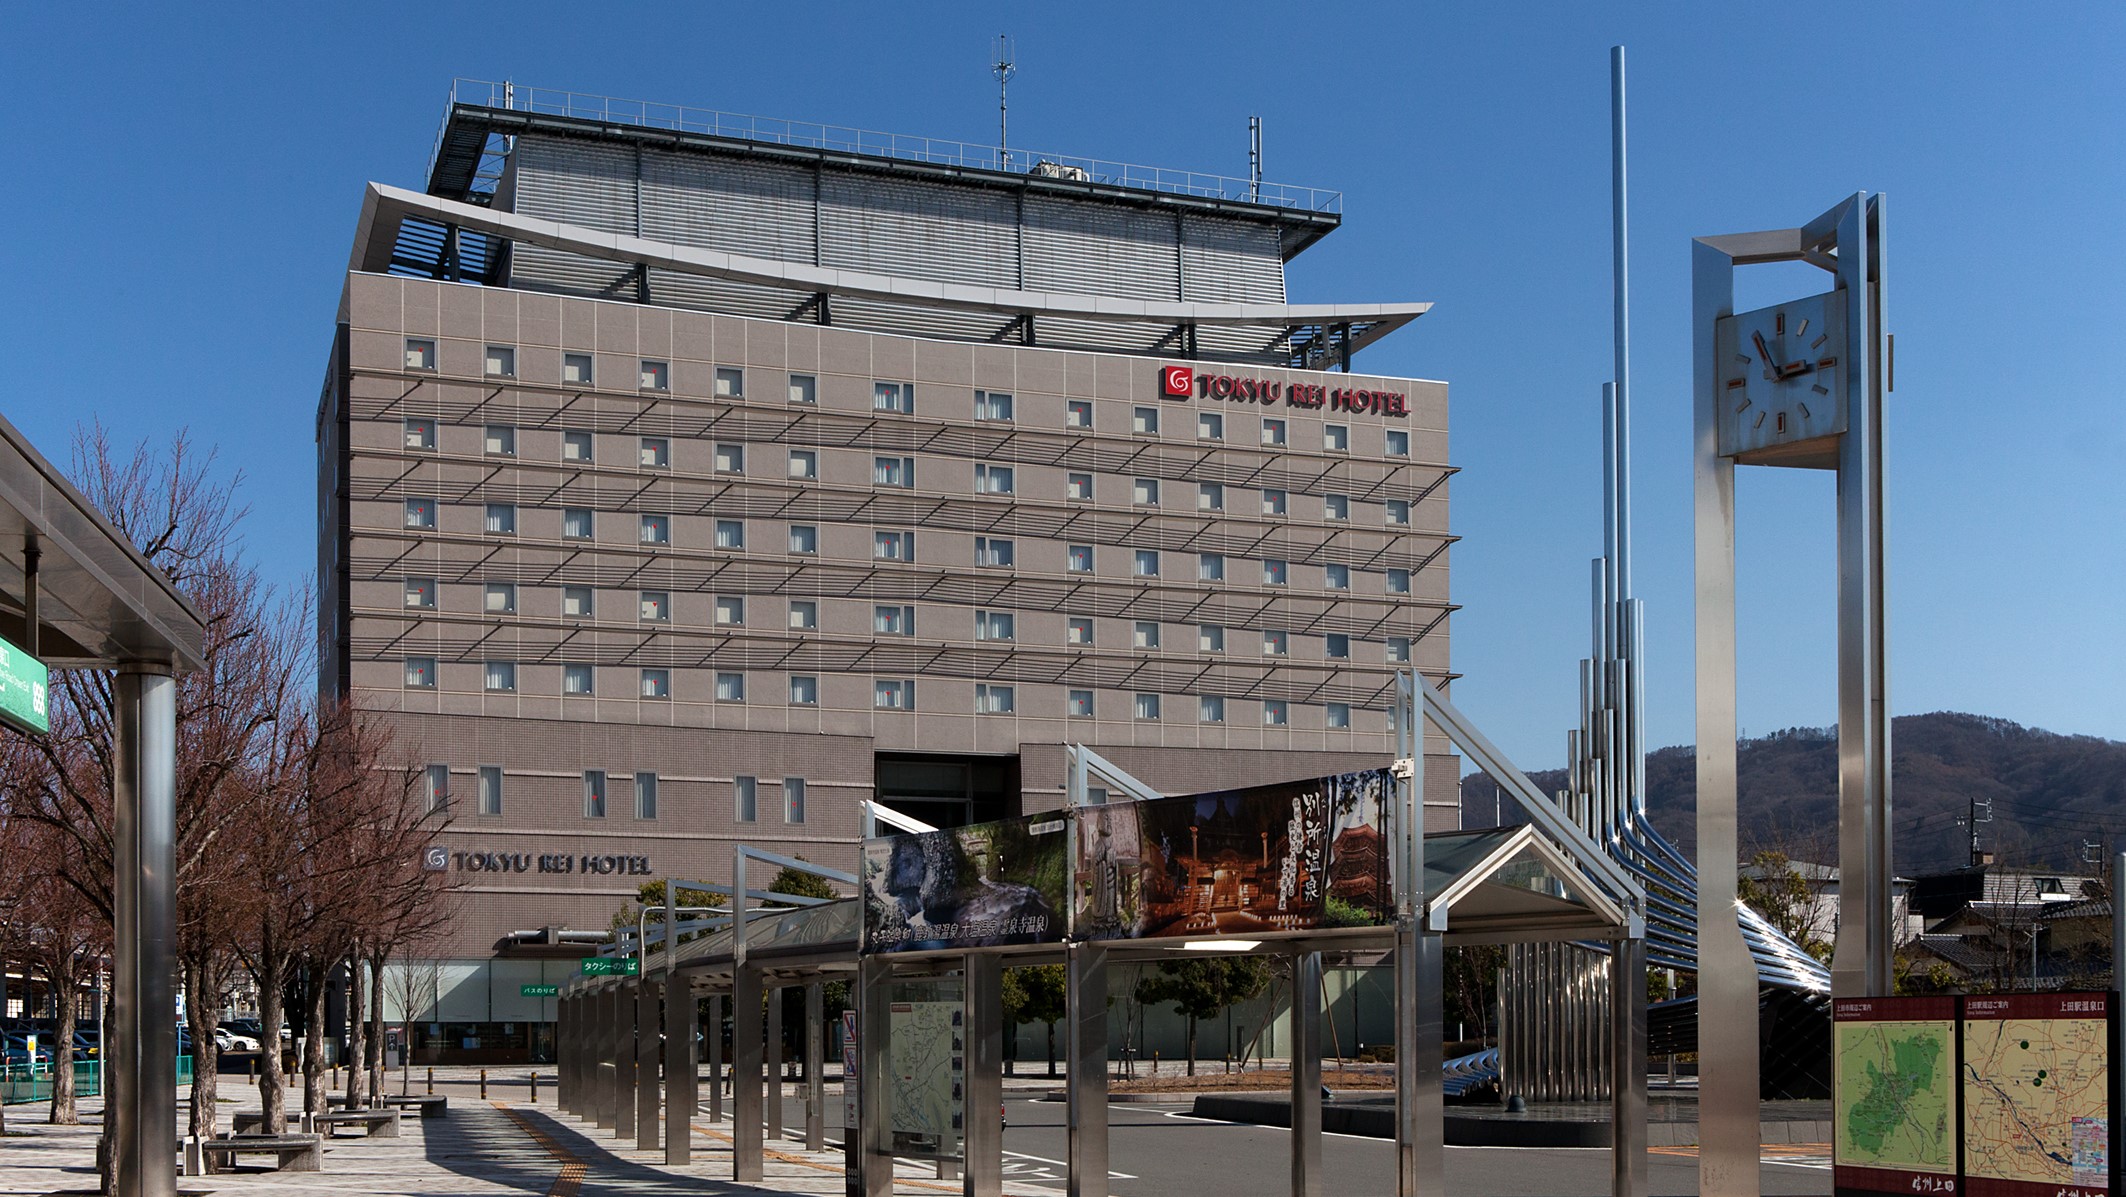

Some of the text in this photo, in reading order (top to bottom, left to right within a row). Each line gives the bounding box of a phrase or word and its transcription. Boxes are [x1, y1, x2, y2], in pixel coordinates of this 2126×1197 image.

[1201, 374, 1411, 414] TOKYU REI HOTEL
[1302, 792, 1322, 901] 別所温泉
[455, 852, 652, 875] TOKYU REI HOTEL
[584, 961, 637, 971] タクシーのりば
[2060, 1000, 2105, 1012] 上田駅温泉口
[389, 1035, 395, 1043] P
